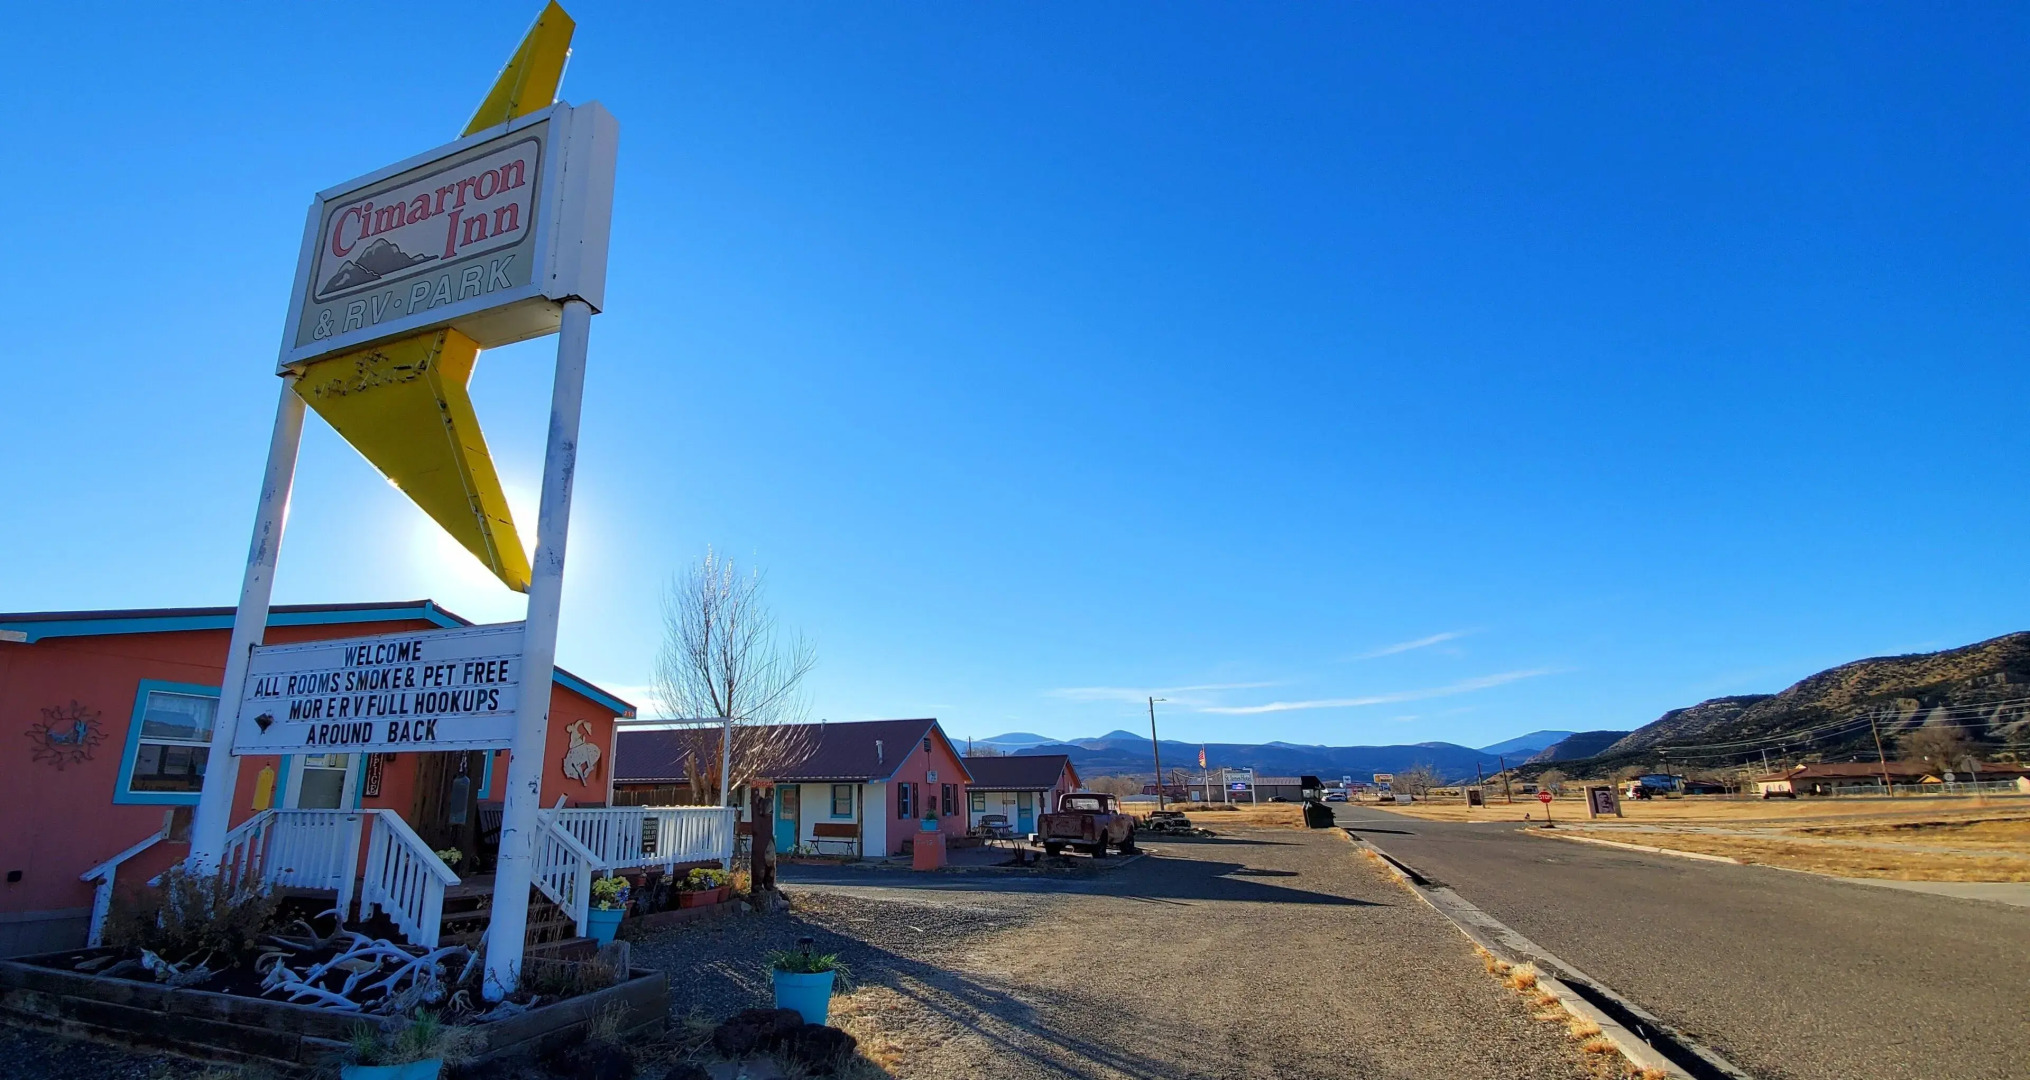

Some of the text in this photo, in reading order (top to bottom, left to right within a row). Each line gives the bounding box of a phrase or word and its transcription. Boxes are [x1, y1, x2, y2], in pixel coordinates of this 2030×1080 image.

[332, 159, 526, 258] Cimarron
[441, 202, 520, 261] Inn
[312, 308, 335, 341] &
[343, 640, 422, 667] WELCOME
[254, 676, 280, 698] ALL
[286, 672, 339, 695] ROOMS
[422, 664, 456, 687] PET
[463, 660, 509, 684] FREE
[366, 694, 408, 716] FULL
[413, 689, 500, 714] HOOKUPS
[305, 718, 437, 745] AROUND BACK
